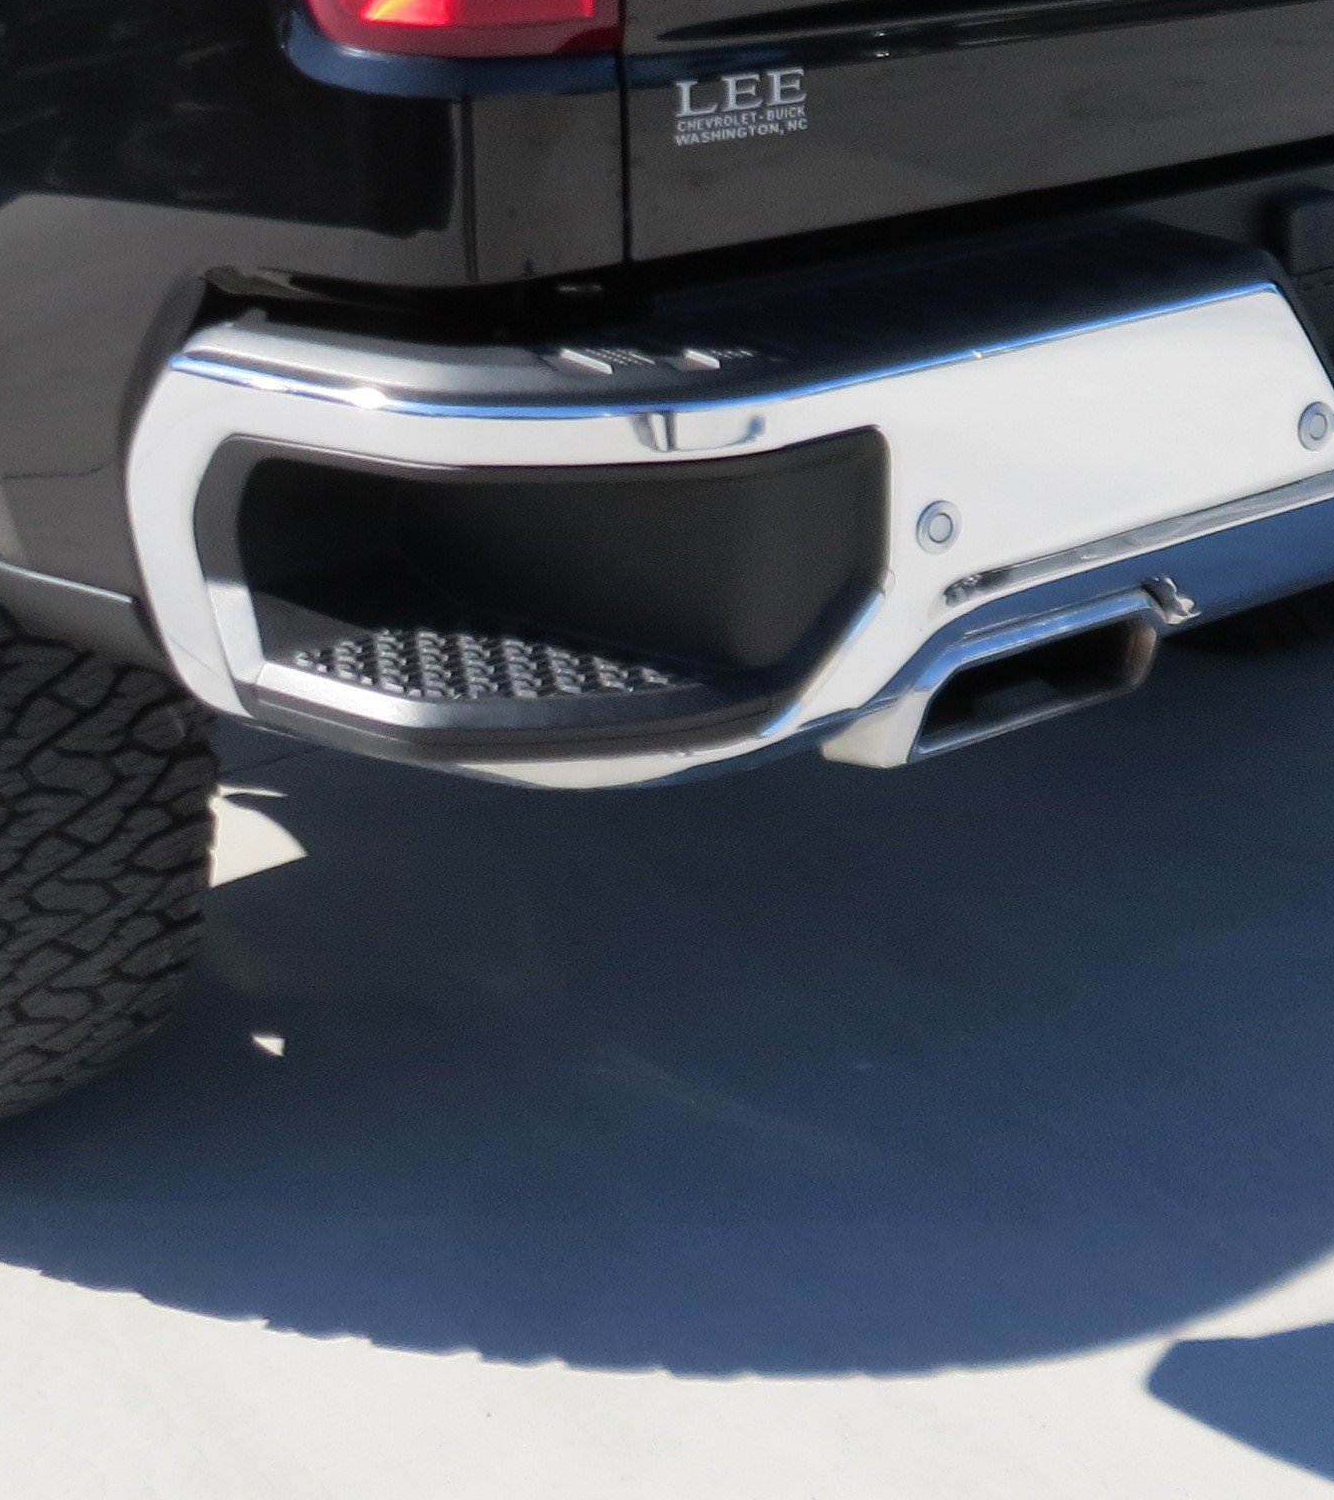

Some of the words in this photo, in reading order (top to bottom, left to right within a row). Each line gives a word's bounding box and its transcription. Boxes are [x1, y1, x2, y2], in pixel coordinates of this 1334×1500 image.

[675, 66, 807, 117] LEE
[675, 122, 785, 146] WASHINGTON,
[787, 117, 808, 131] NC
